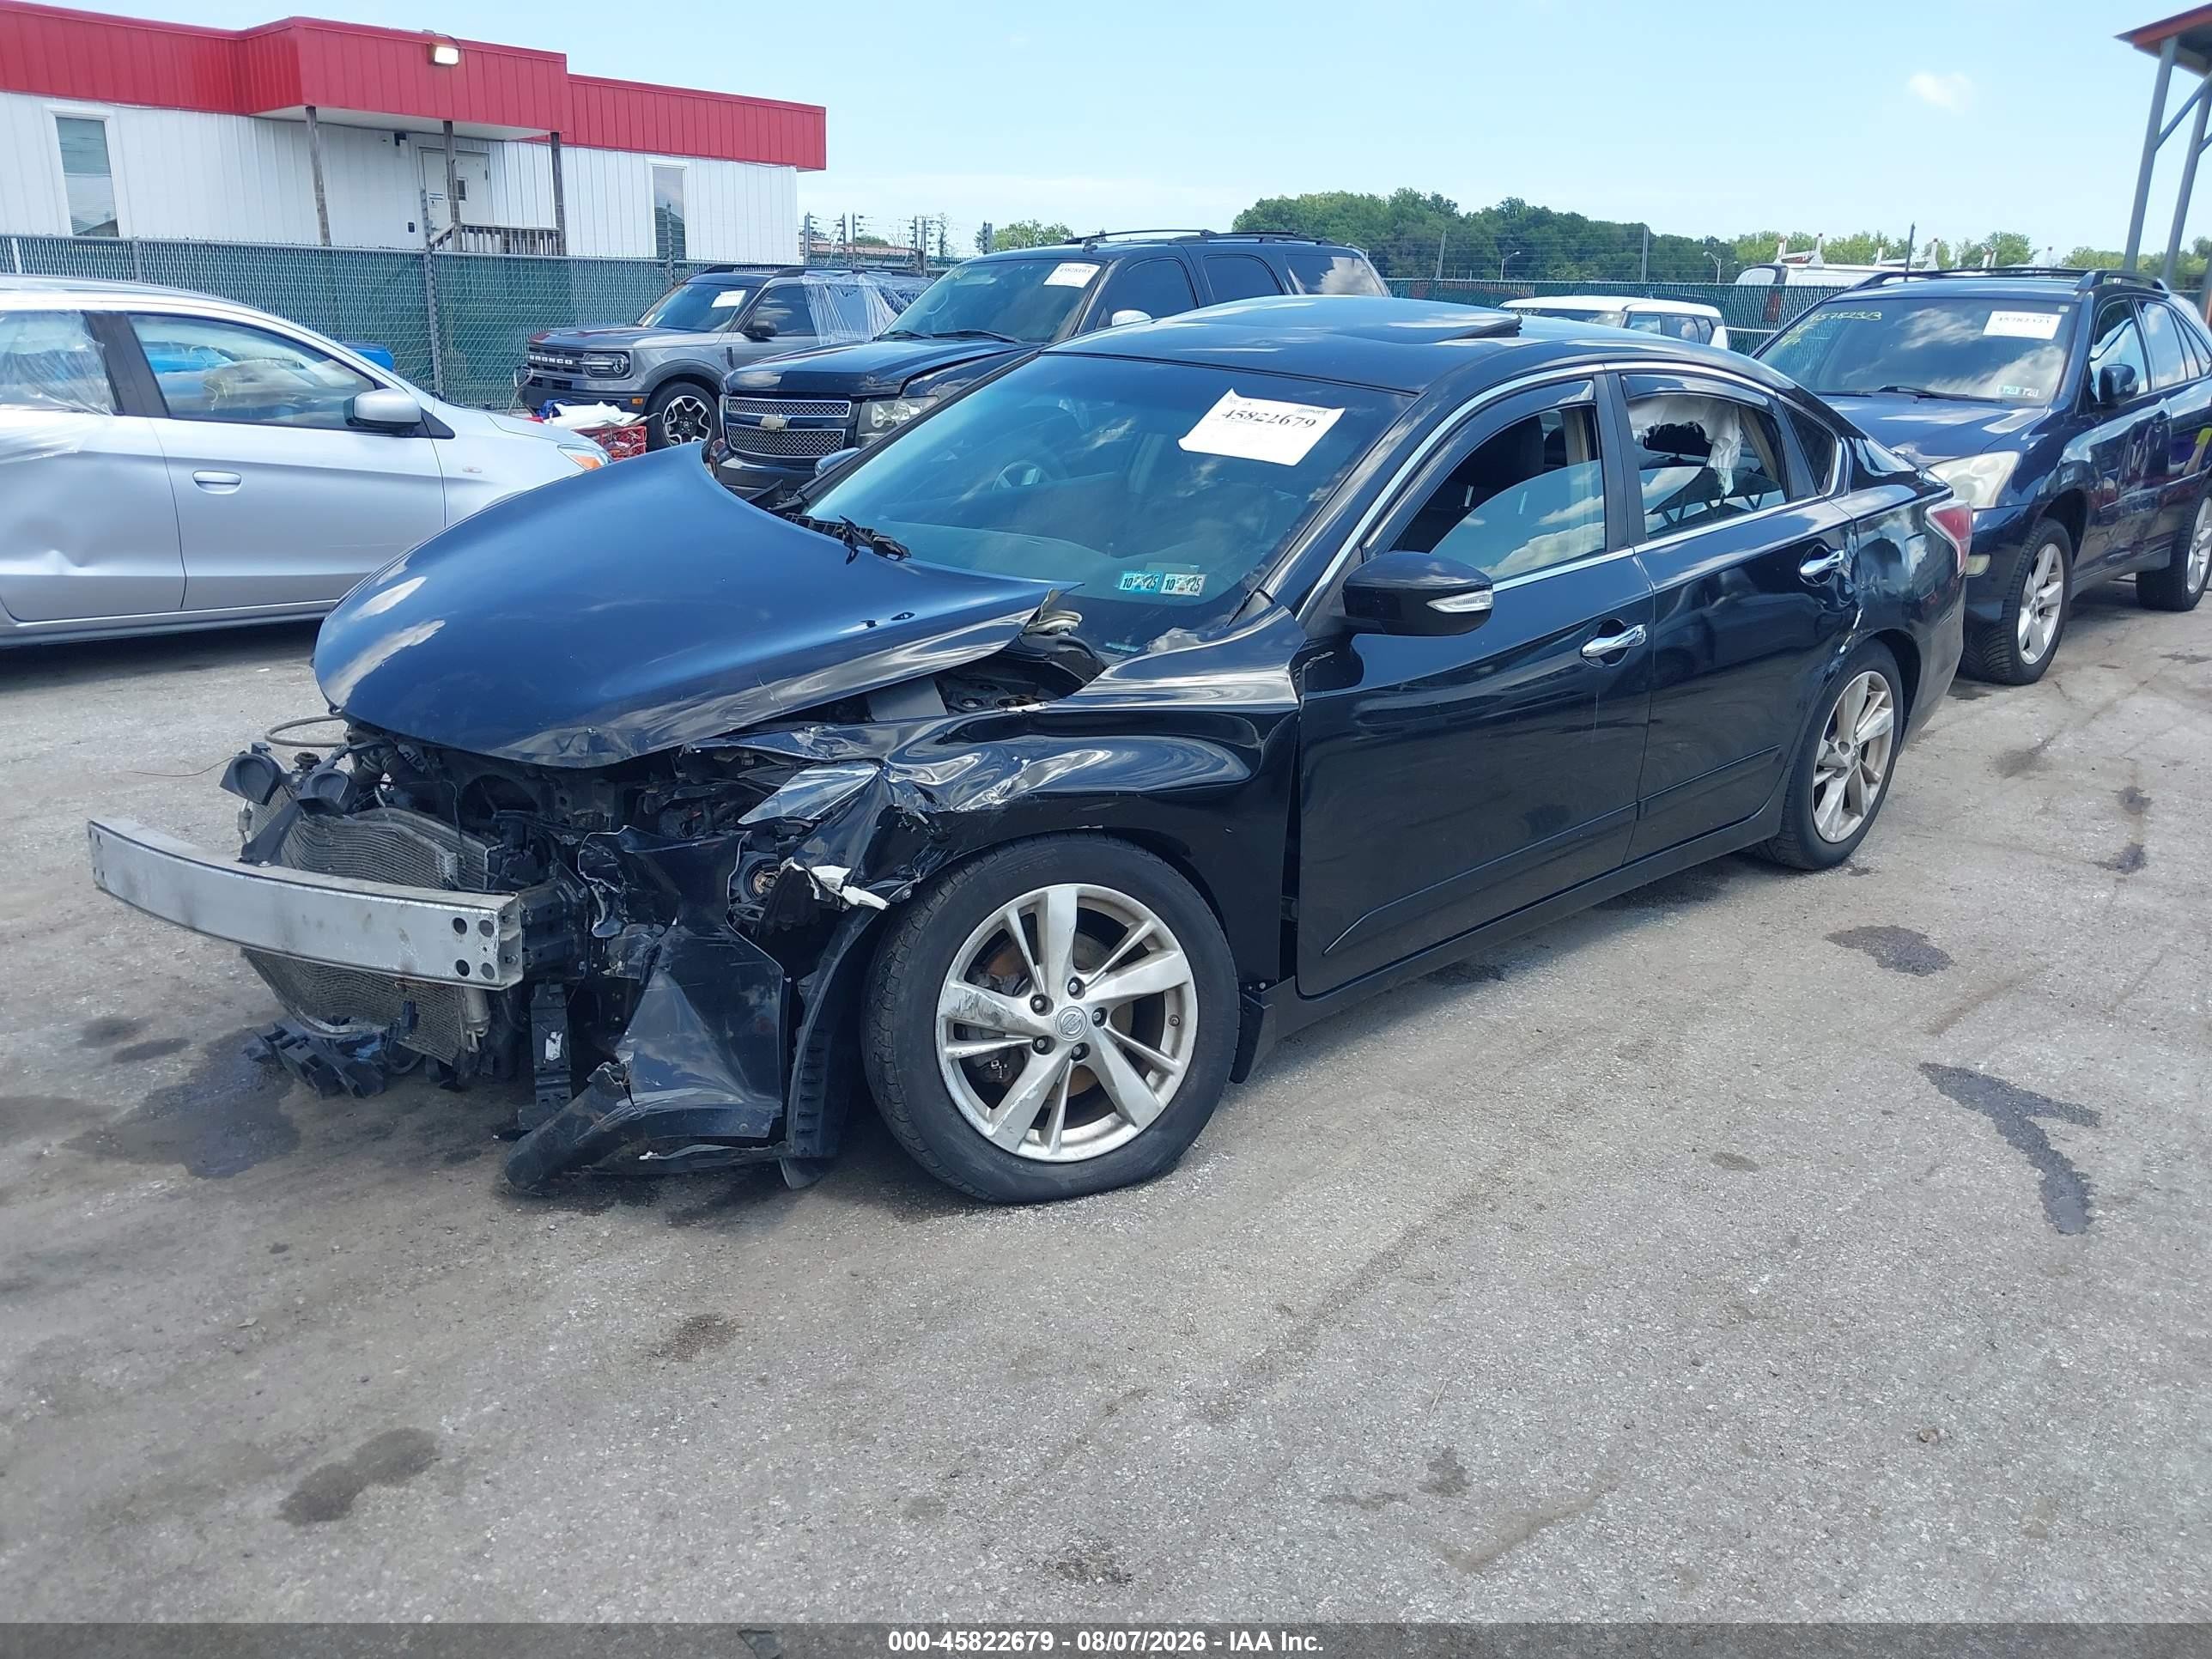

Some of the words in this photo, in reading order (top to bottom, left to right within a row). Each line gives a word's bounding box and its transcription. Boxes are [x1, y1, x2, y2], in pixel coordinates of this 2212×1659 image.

[529, 355, 574, 365] BRONCO
[1222, 409, 1317, 428] 45822679
[1122, 577, 1133, 589] 10
[1164, 579, 1176, 591] 10
[1189, 576, 1202, 592] 25
